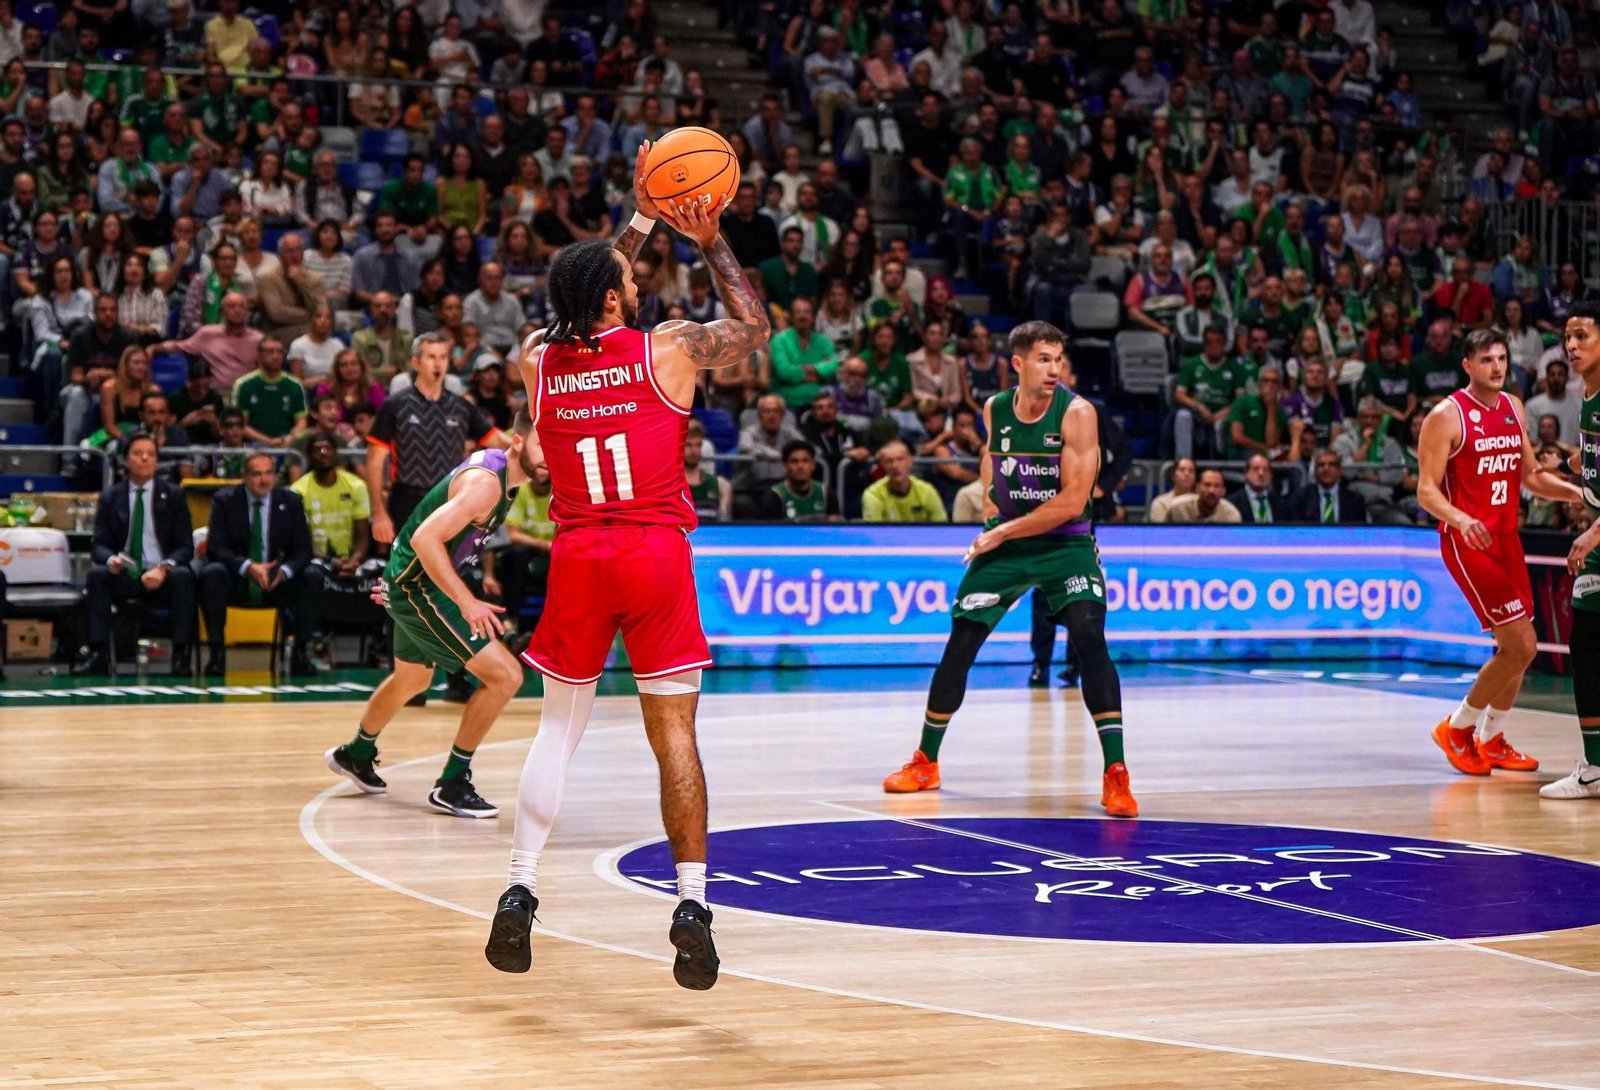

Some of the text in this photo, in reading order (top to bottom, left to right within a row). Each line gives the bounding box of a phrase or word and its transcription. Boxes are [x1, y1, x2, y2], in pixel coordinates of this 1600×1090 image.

[547, 365, 631, 395] LIVINGSTON
[556, 402, 637, 420] Kave Home
[1474, 435, 1521, 452] GIRONA
[575, 432, 635, 505] 11
[1477, 453, 1521, 475] FIATC
[1009, 486, 1057, 502] málaga
[1491, 480, 1507, 505] 23
[719, 568, 951, 626] Viajar ya
[1101, 567, 1422, 620] blanco o negro
[1034, 871, 1352, 903] Resort
